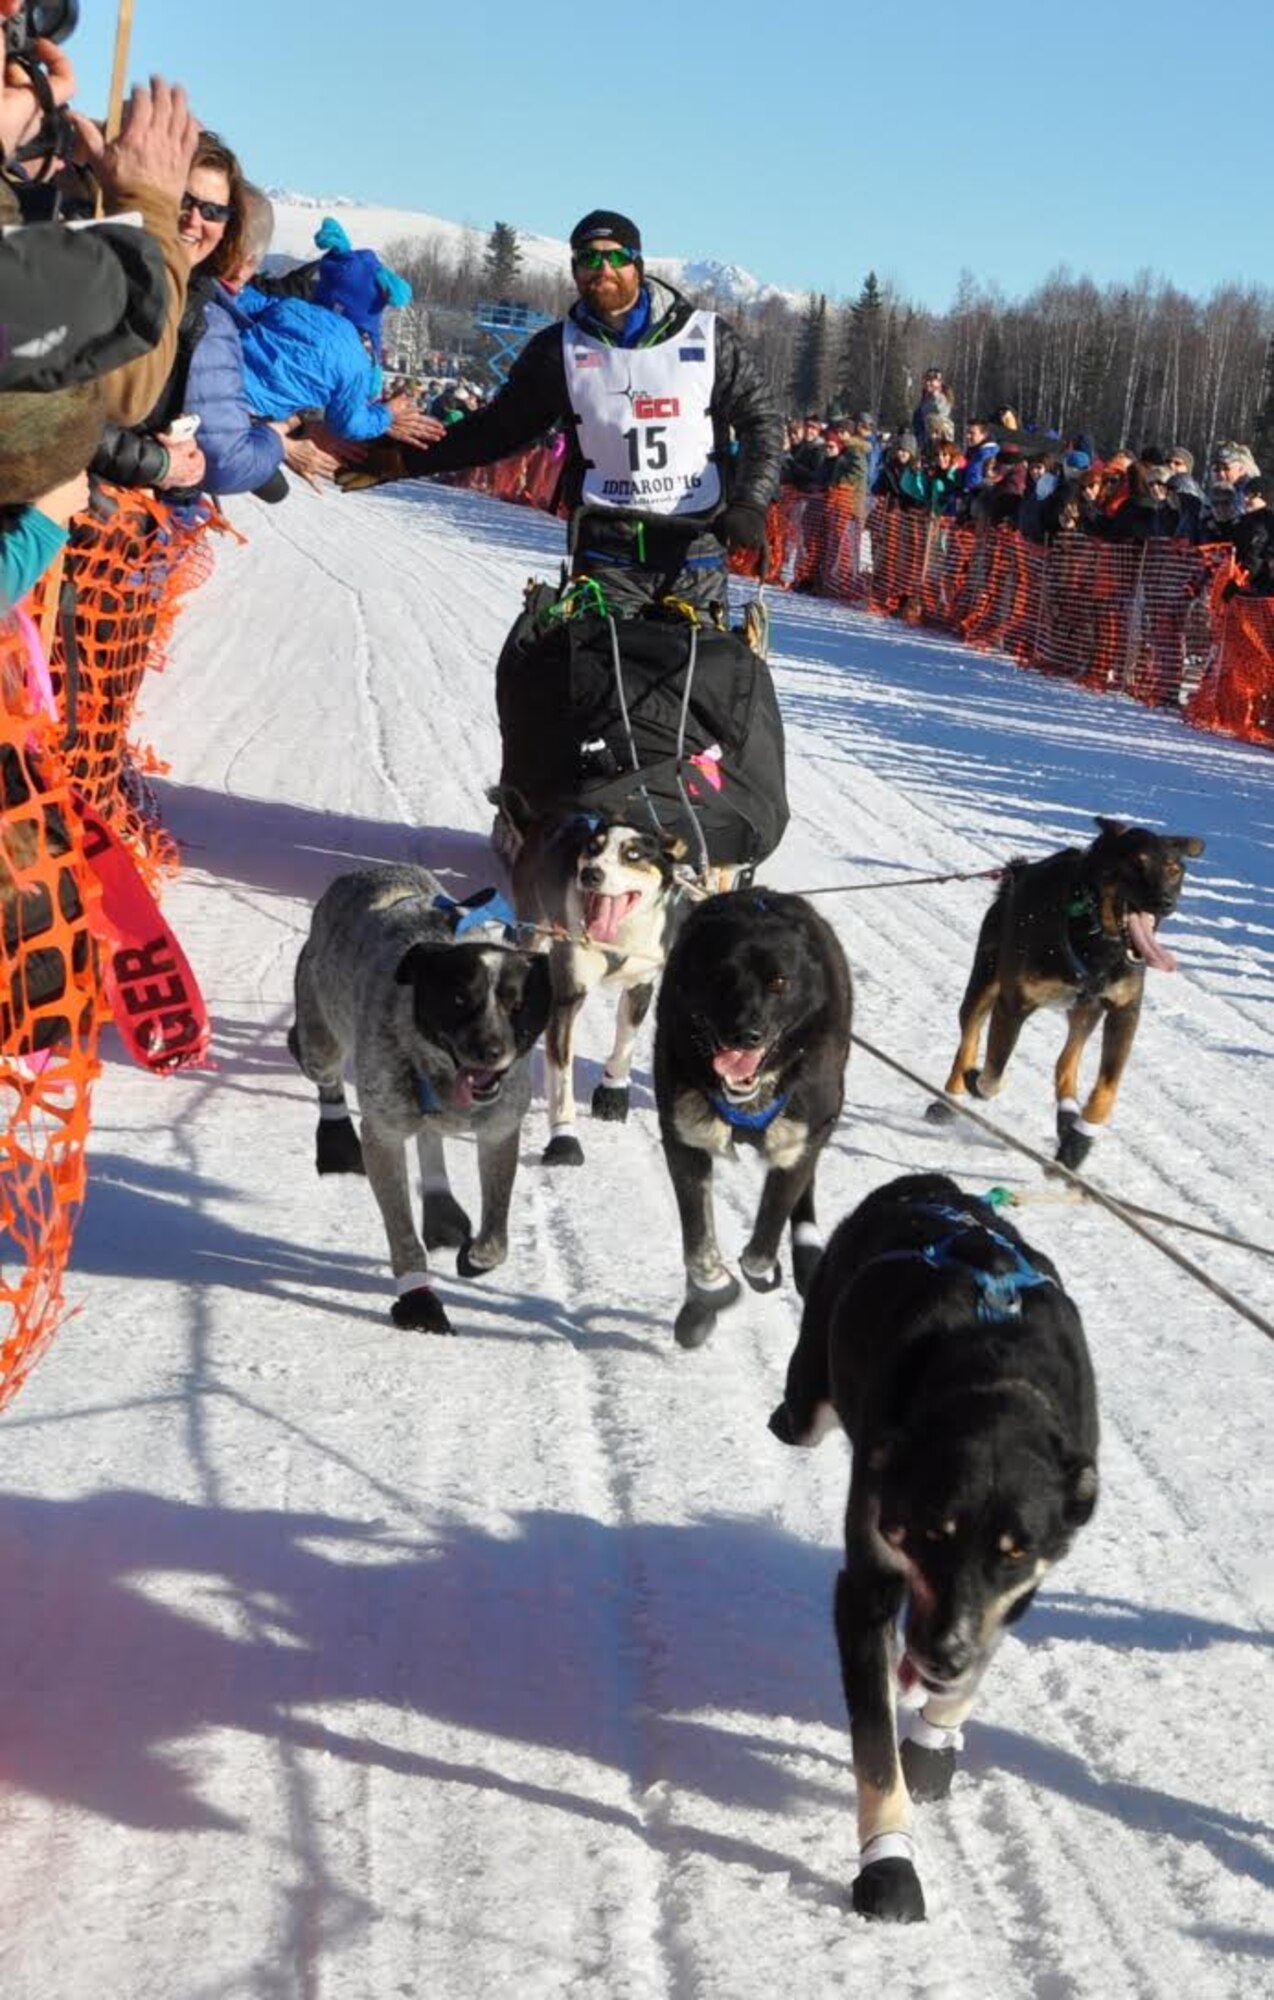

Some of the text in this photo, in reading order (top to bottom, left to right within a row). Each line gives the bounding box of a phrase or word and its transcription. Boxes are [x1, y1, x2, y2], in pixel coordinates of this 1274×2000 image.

[634, 396, 680, 420] GCI
[622, 426, 667, 471] 15
[602, 472, 702, 496] IDITAROD '16
